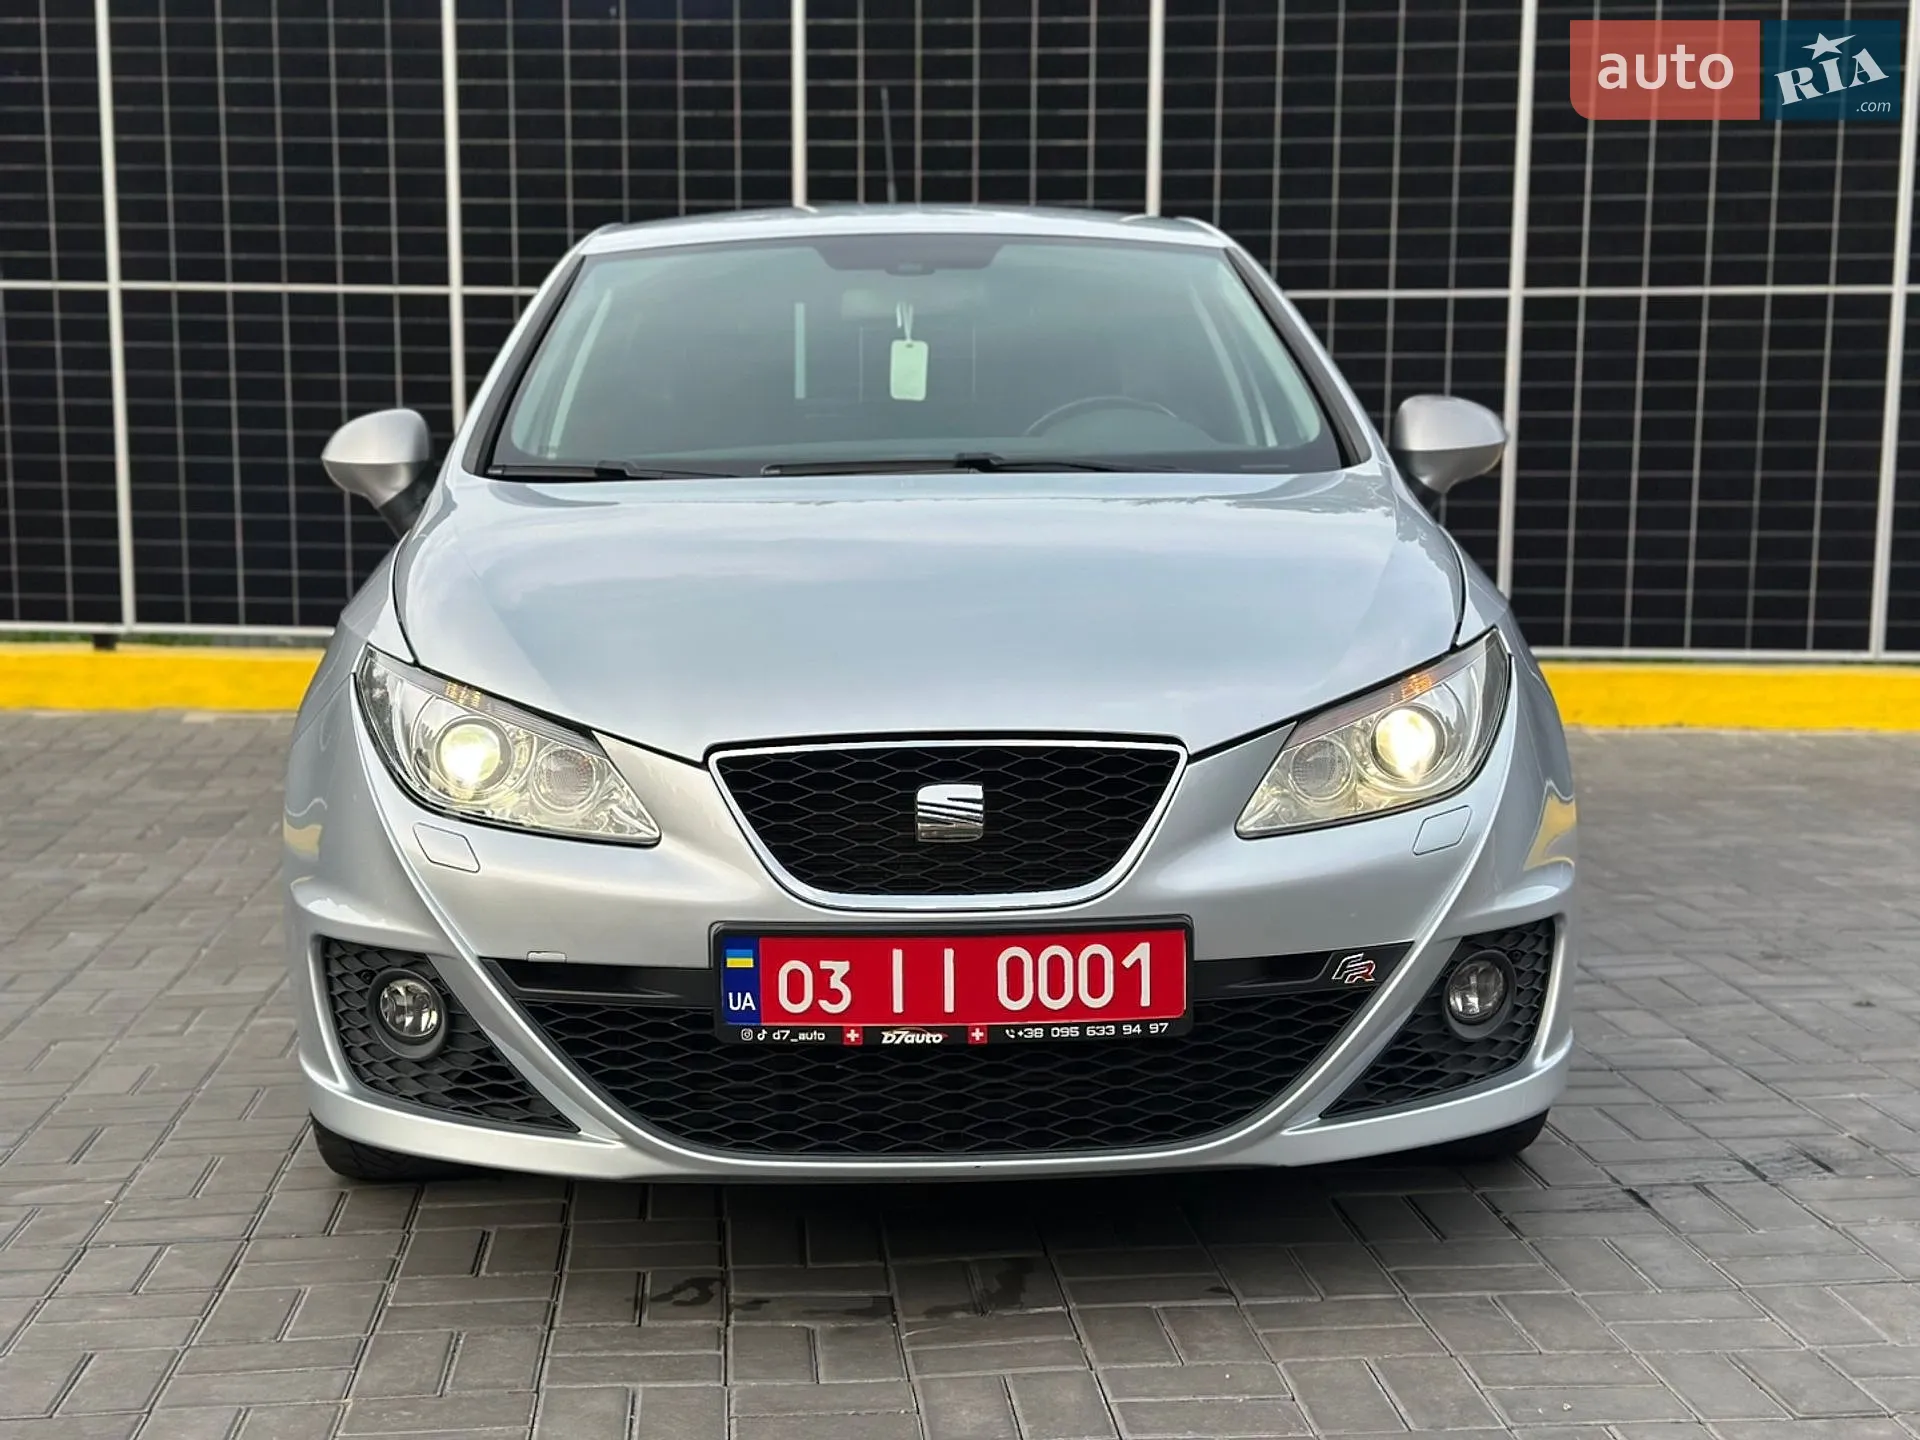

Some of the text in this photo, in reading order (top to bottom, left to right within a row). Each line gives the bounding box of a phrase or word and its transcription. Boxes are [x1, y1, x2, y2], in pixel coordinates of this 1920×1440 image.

[1331, 952, 1375, 984] FR
[778, 959, 852, 1014] 03
[997, 942, 1151, 1011] 0001
[728, 992, 756, 1011] UA
[772, 1030, 826, 1042] d7_auto
[1017, 1022, 1169, 1039] +38 095 633 94 97
